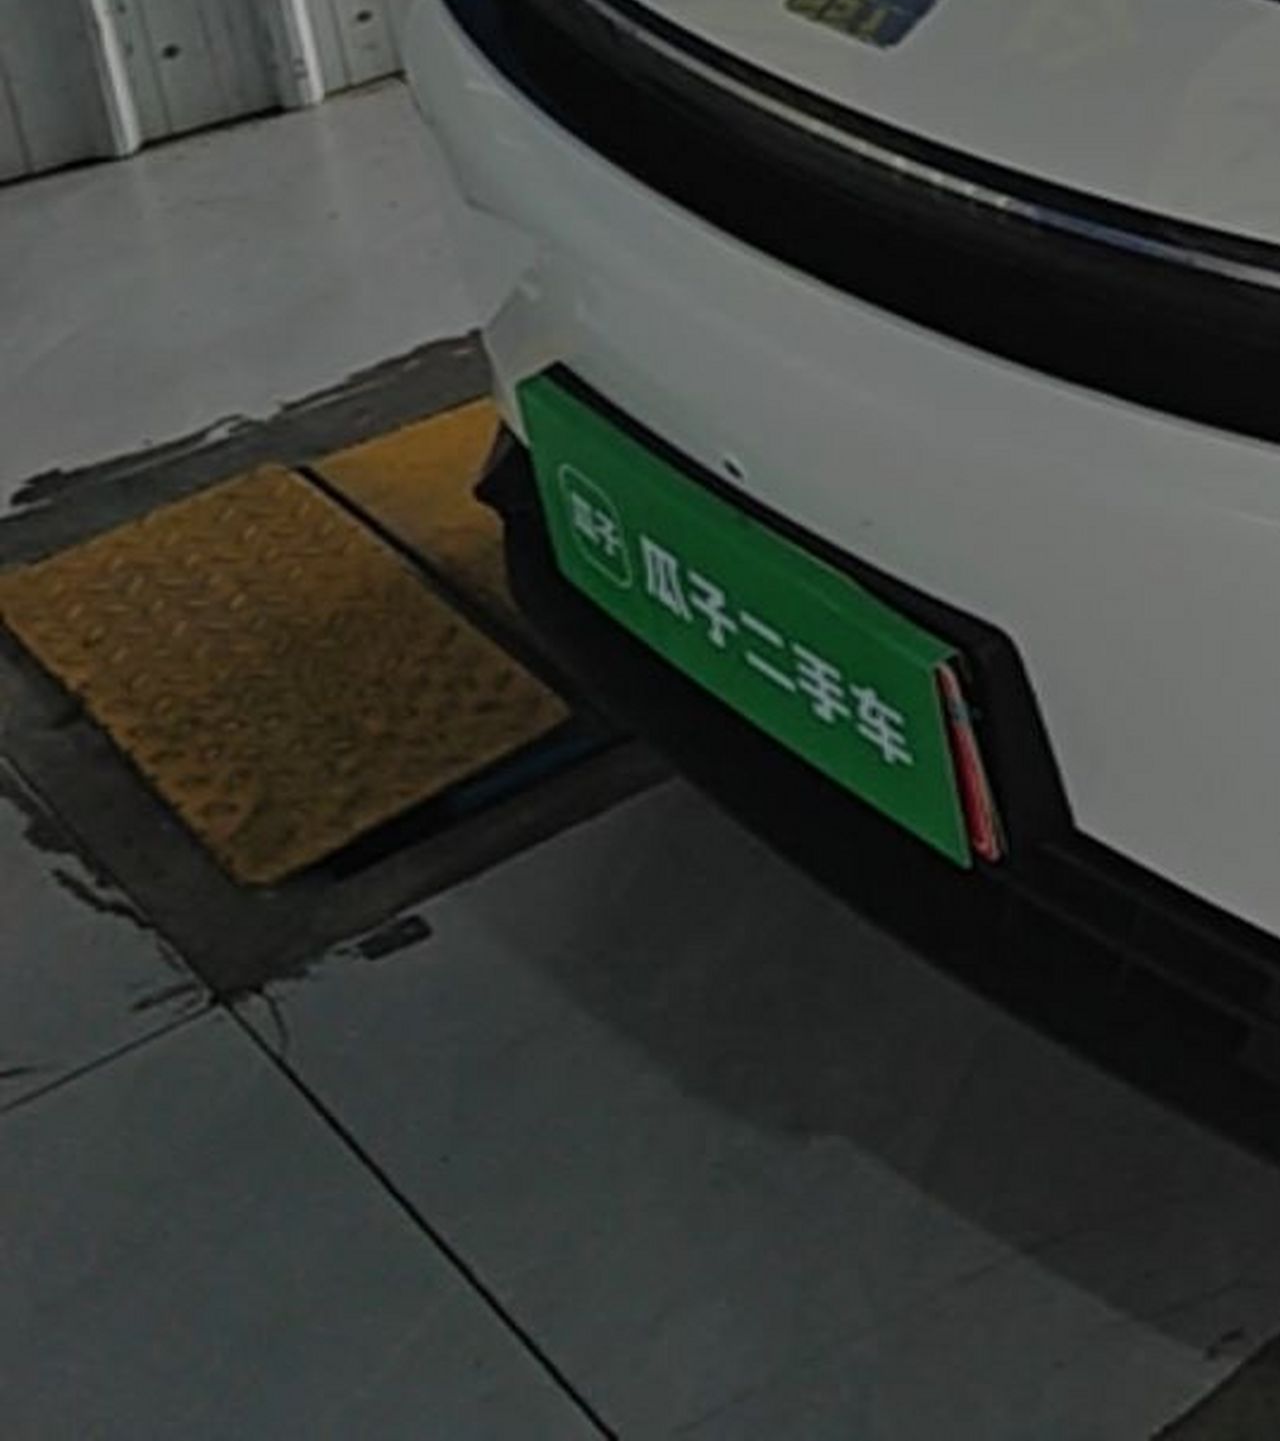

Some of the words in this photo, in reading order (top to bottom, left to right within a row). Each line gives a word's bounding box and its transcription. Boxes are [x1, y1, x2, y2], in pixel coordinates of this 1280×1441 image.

[639, 534, 914, 768] 瓜子二手车
